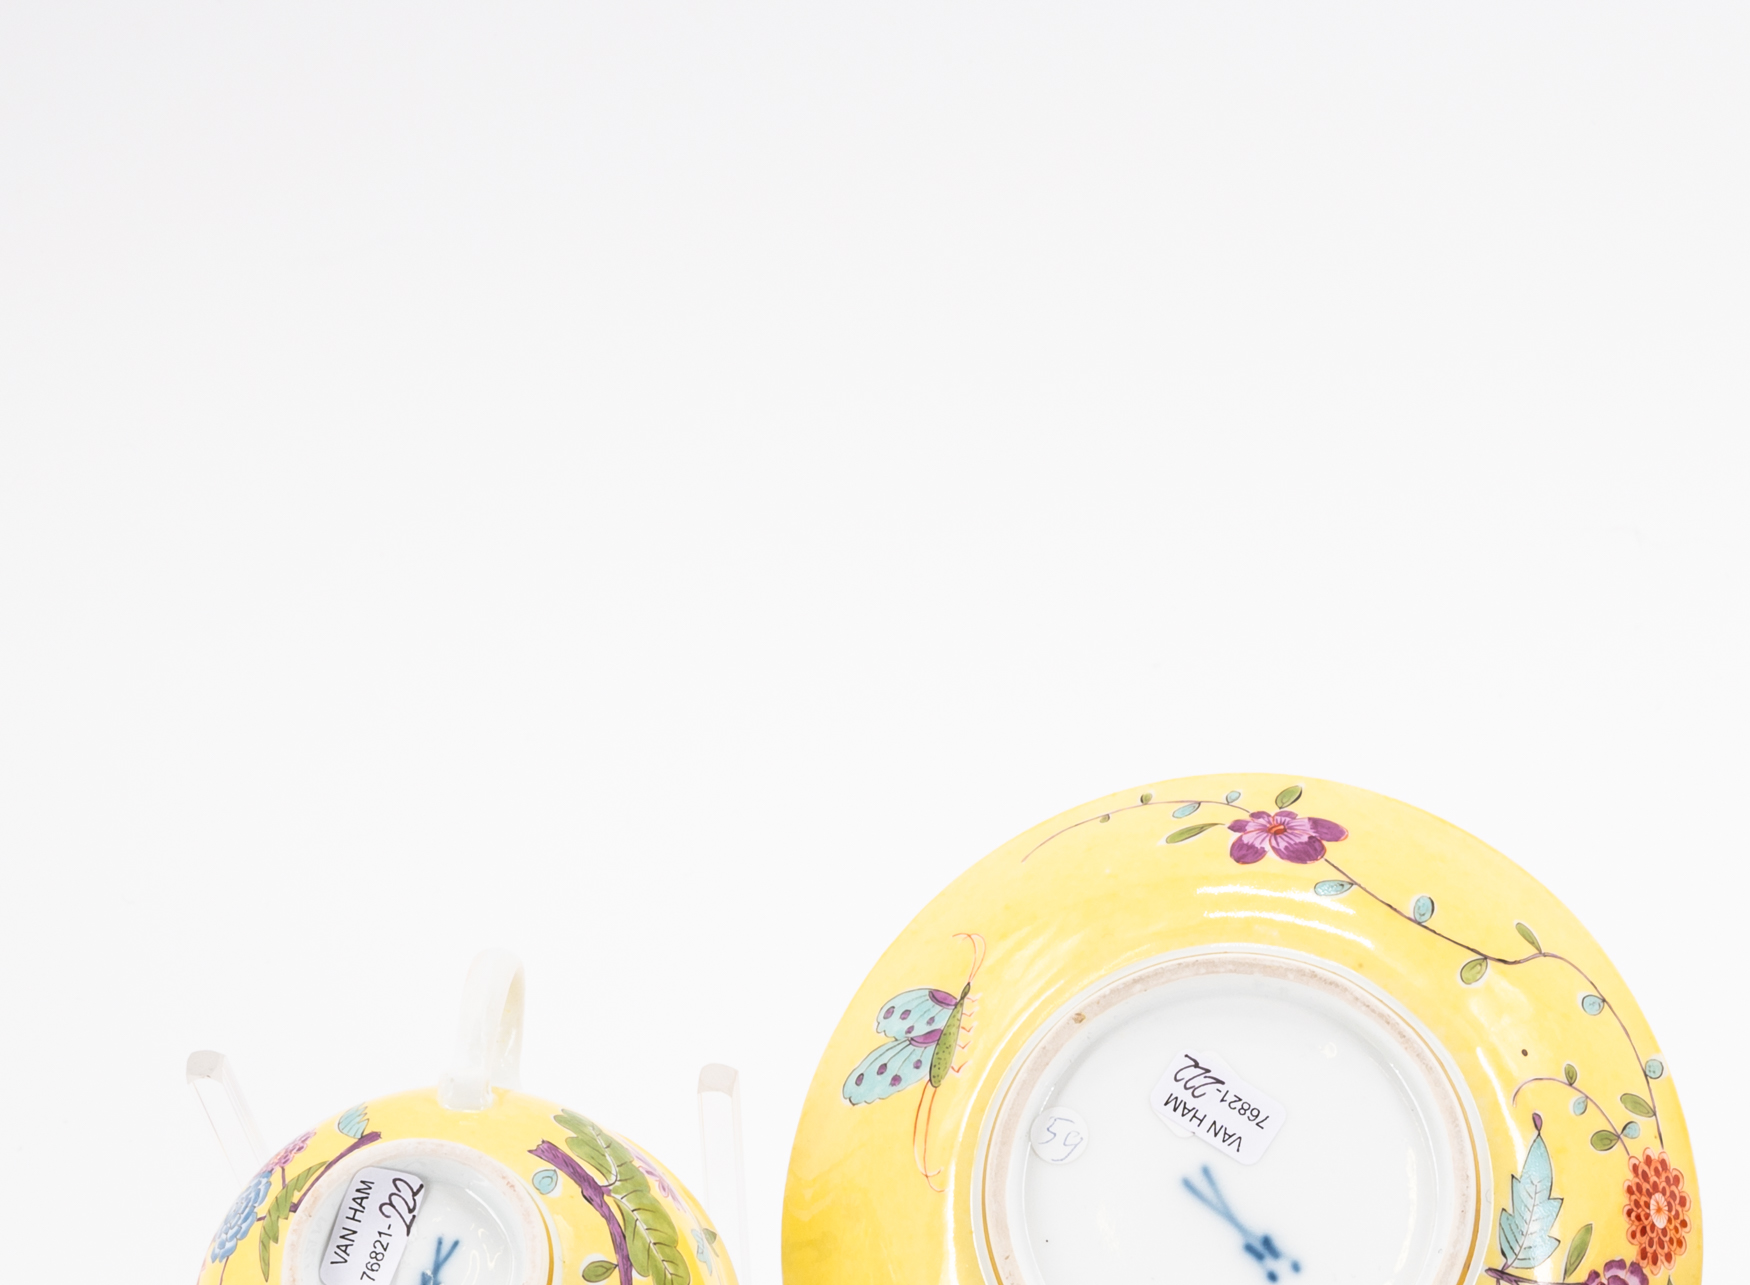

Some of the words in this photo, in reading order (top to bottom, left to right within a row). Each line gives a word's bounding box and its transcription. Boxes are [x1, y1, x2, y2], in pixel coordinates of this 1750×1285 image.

[1163, 1093, 1207, 1128] HAM
[1206, 1120, 1242, 1153] VAN
[329, 1226, 358, 1265] VAN
[346, 1179, 375, 1223] HAM
